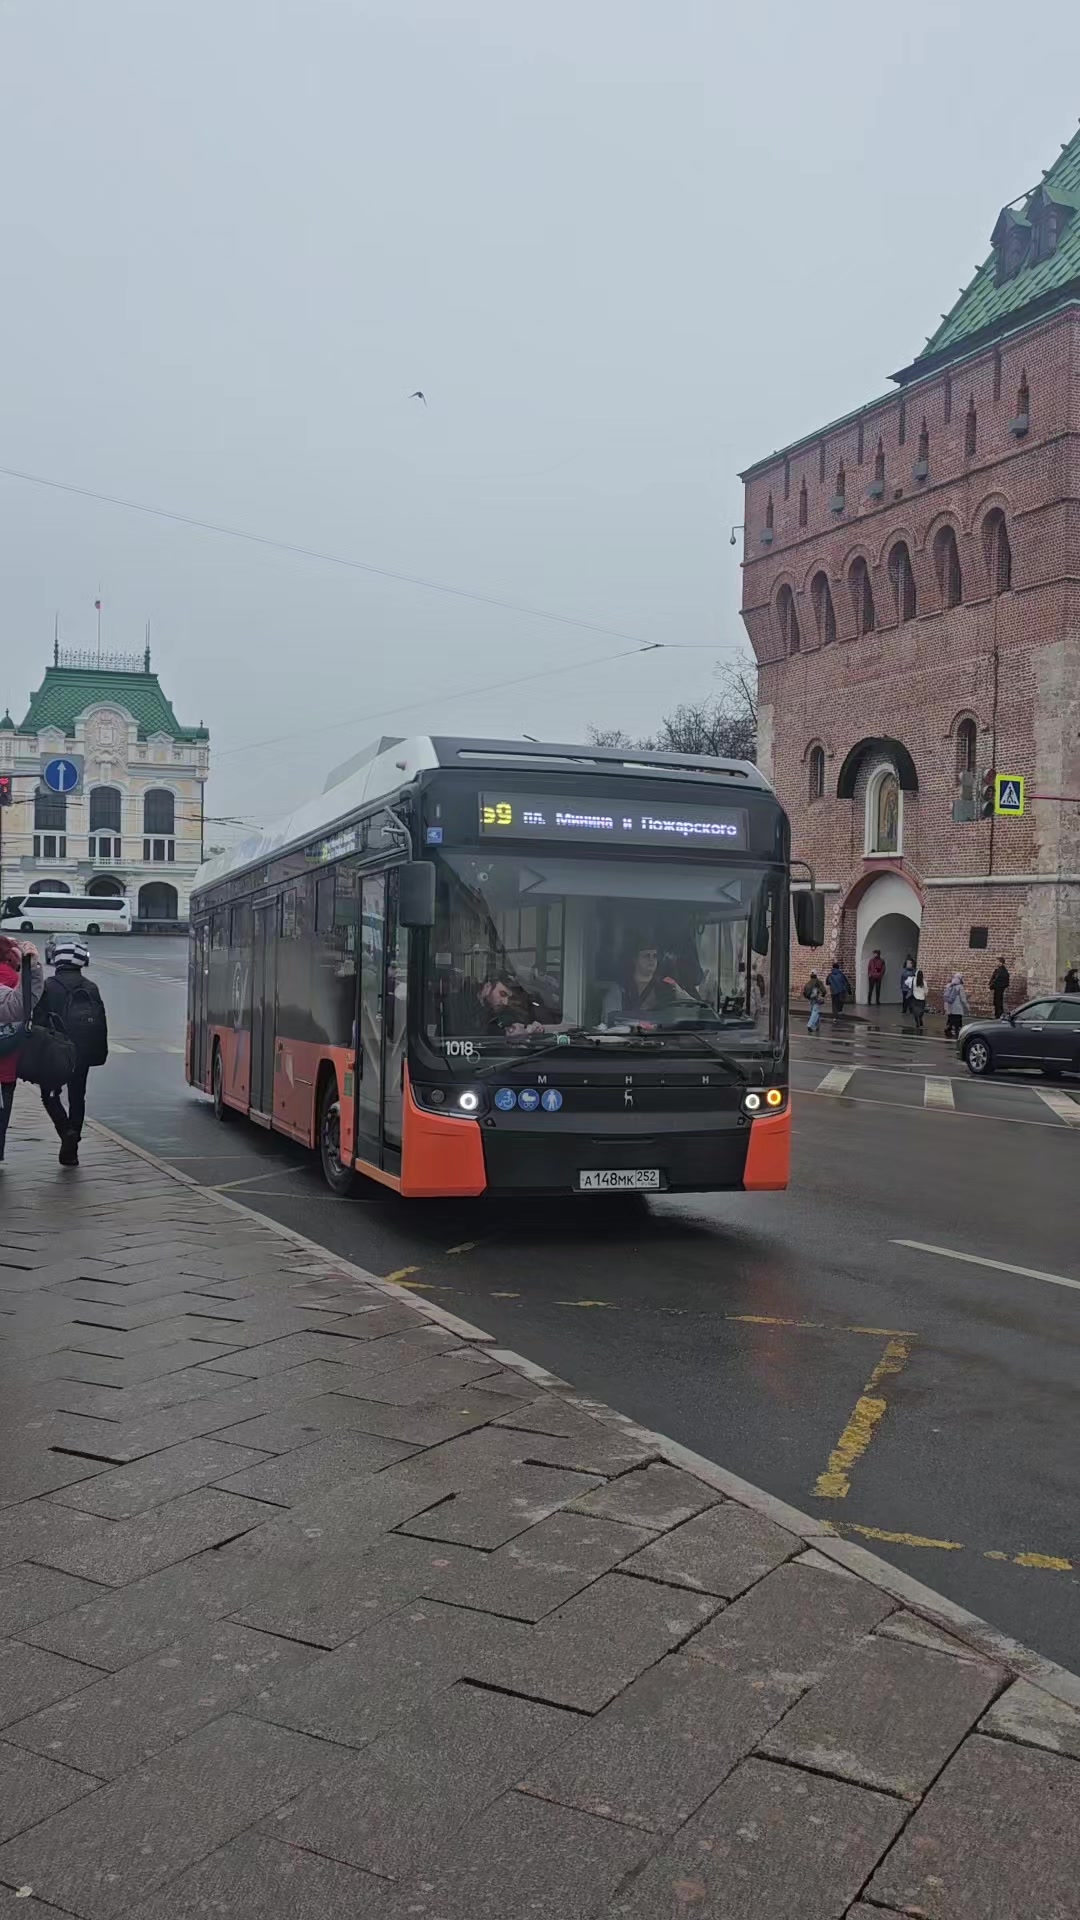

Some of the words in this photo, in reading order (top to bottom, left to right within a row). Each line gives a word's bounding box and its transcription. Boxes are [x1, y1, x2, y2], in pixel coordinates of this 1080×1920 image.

[523, 811, 546, 825] пл.
[622, 818, 632, 830] и
[641, 816, 737, 836] Пожарского
[445, 1041, 474, 1056] 1018
[637, 1170, 656, 1182] 252
